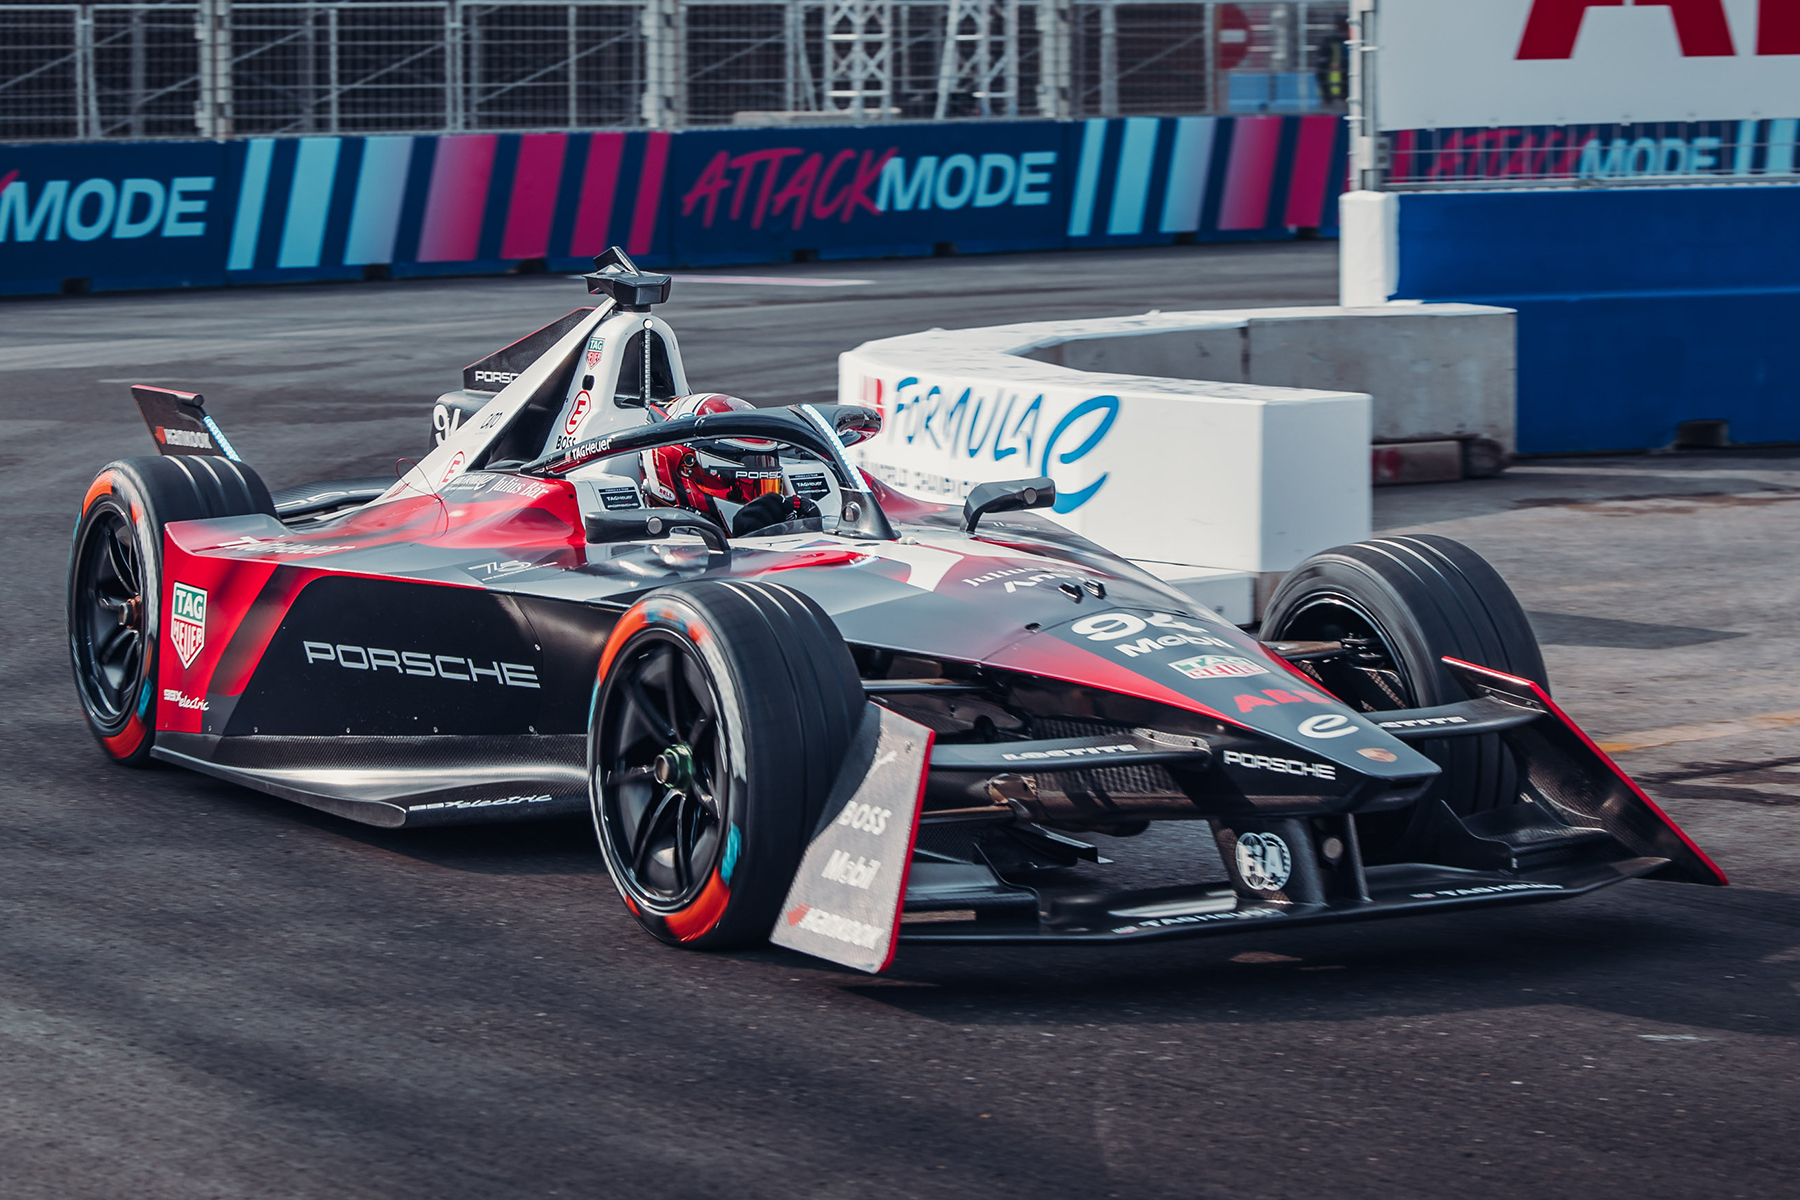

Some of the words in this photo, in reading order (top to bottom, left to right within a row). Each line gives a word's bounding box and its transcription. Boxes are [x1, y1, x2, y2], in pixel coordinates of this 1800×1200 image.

[682, 147, 899, 230] ATTACK
[876, 152, 1057, 212] MODE
[0, 176, 215, 242] MODE
[886, 376, 1044, 470] FORMULA
[486, 476, 526, 495] Julius
[519, 481, 550, 500] Bär
[176, 589, 204, 621] TAG
[173, 618, 203, 663] HEUER
[1113, 633, 1236, 658] Mobil
[303, 640, 541, 688] PORSCHE
[1001, 743, 1138, 761] LOCTITE
[1223, 750, 1336, 781] PORSCHE
[838, 800, 893, 836] BOSS
[821, 849, 882, 890] Mobil
